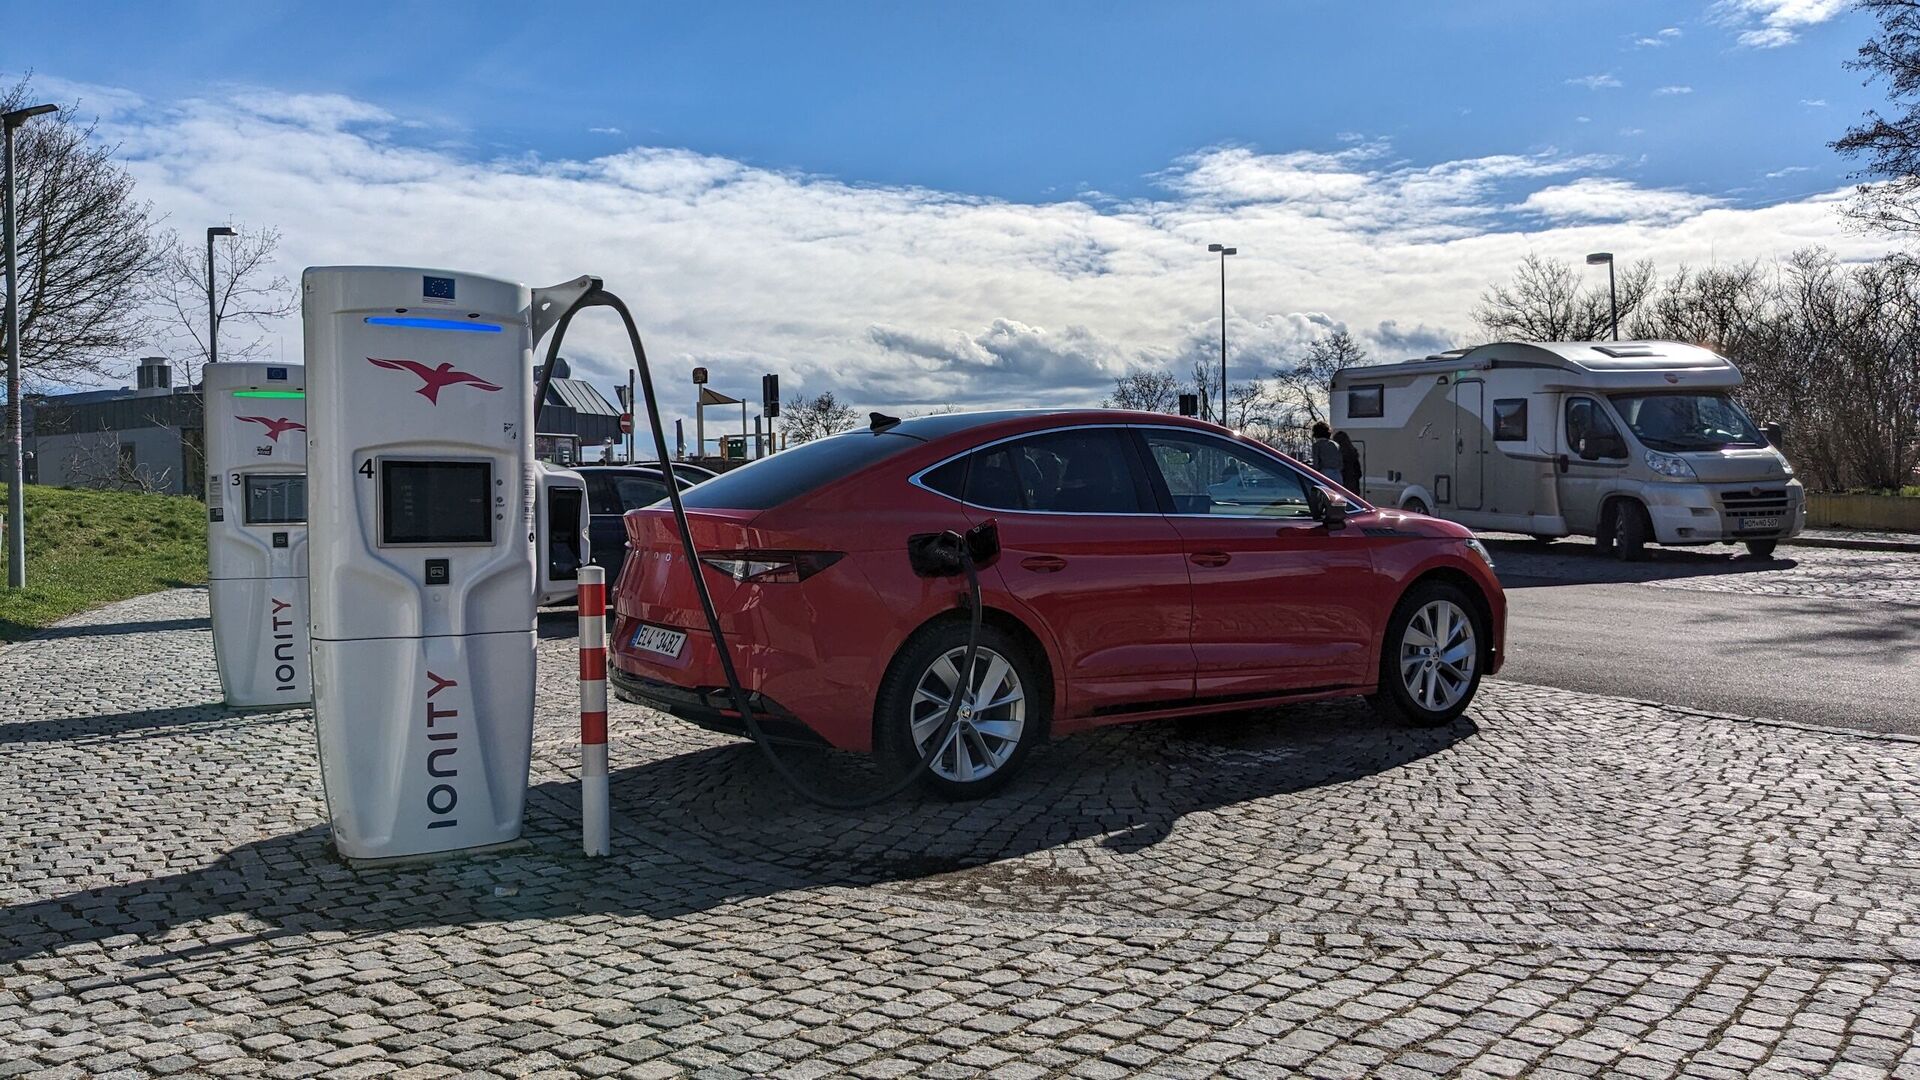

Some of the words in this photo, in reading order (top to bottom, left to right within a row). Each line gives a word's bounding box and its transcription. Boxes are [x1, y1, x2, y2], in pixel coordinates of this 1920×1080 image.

[231, 473, 241, 486] 3
[358, 458, 375, 479] 4
[272, 598, 296, 691] IONITY
[427, 670, 458, 830] IONITY
